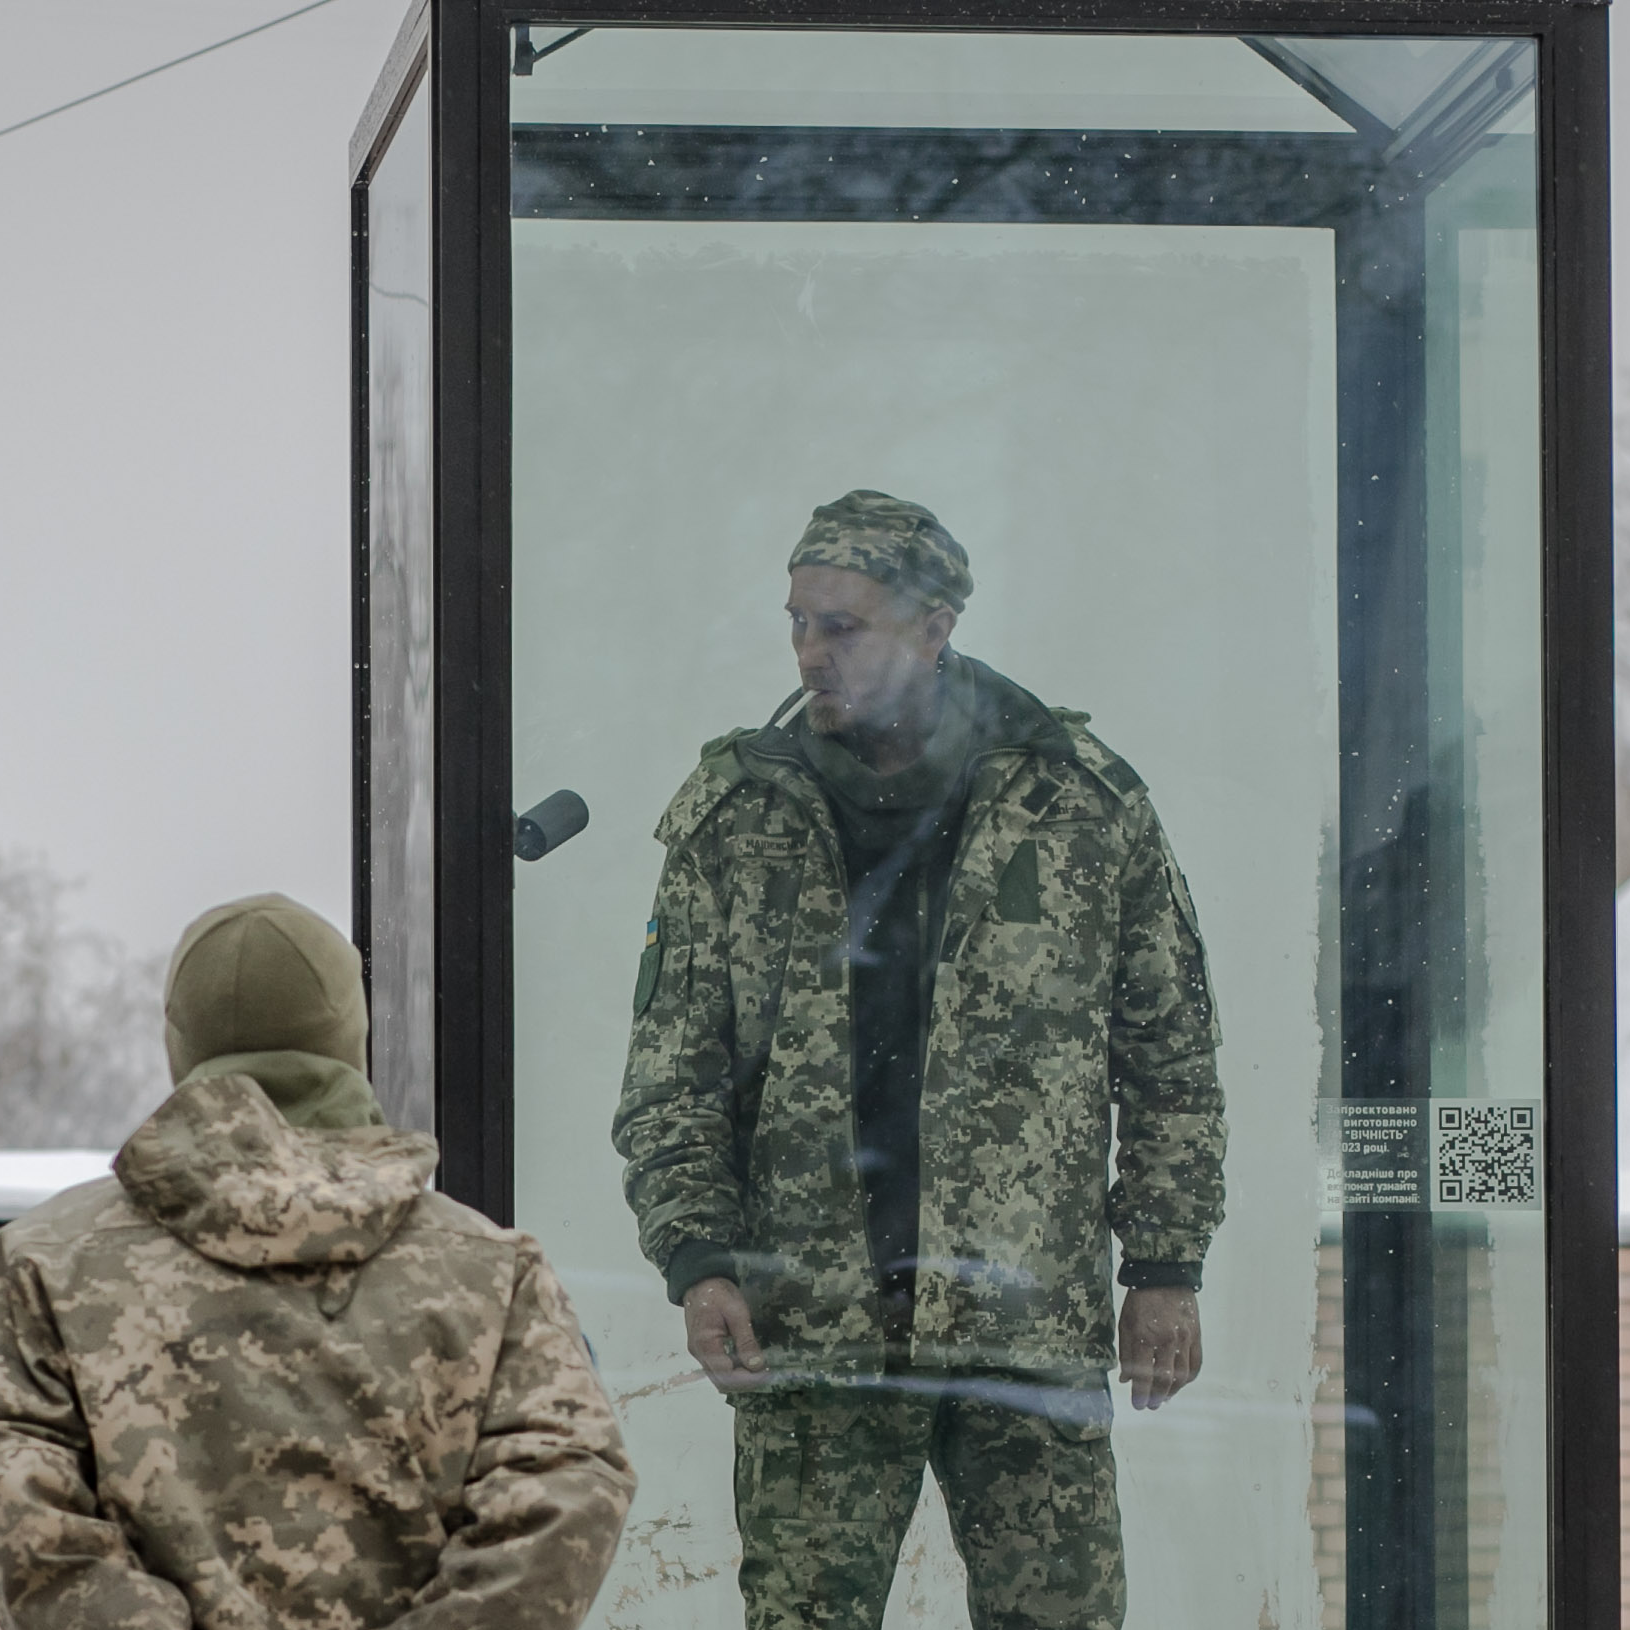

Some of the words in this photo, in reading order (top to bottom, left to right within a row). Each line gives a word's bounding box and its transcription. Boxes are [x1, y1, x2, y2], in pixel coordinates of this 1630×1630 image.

[1344, 1119, 1418, 1128] виготовлено
[1336, 1143, 1361, 1152] 023
[1396, 1170, 1418, 1181] про
[1327, 1182, 1375, 1191] екпонат
[1376, 1180, 1418, 1193] узнайте
[1344, 1193, 1371, 1204] сайті
